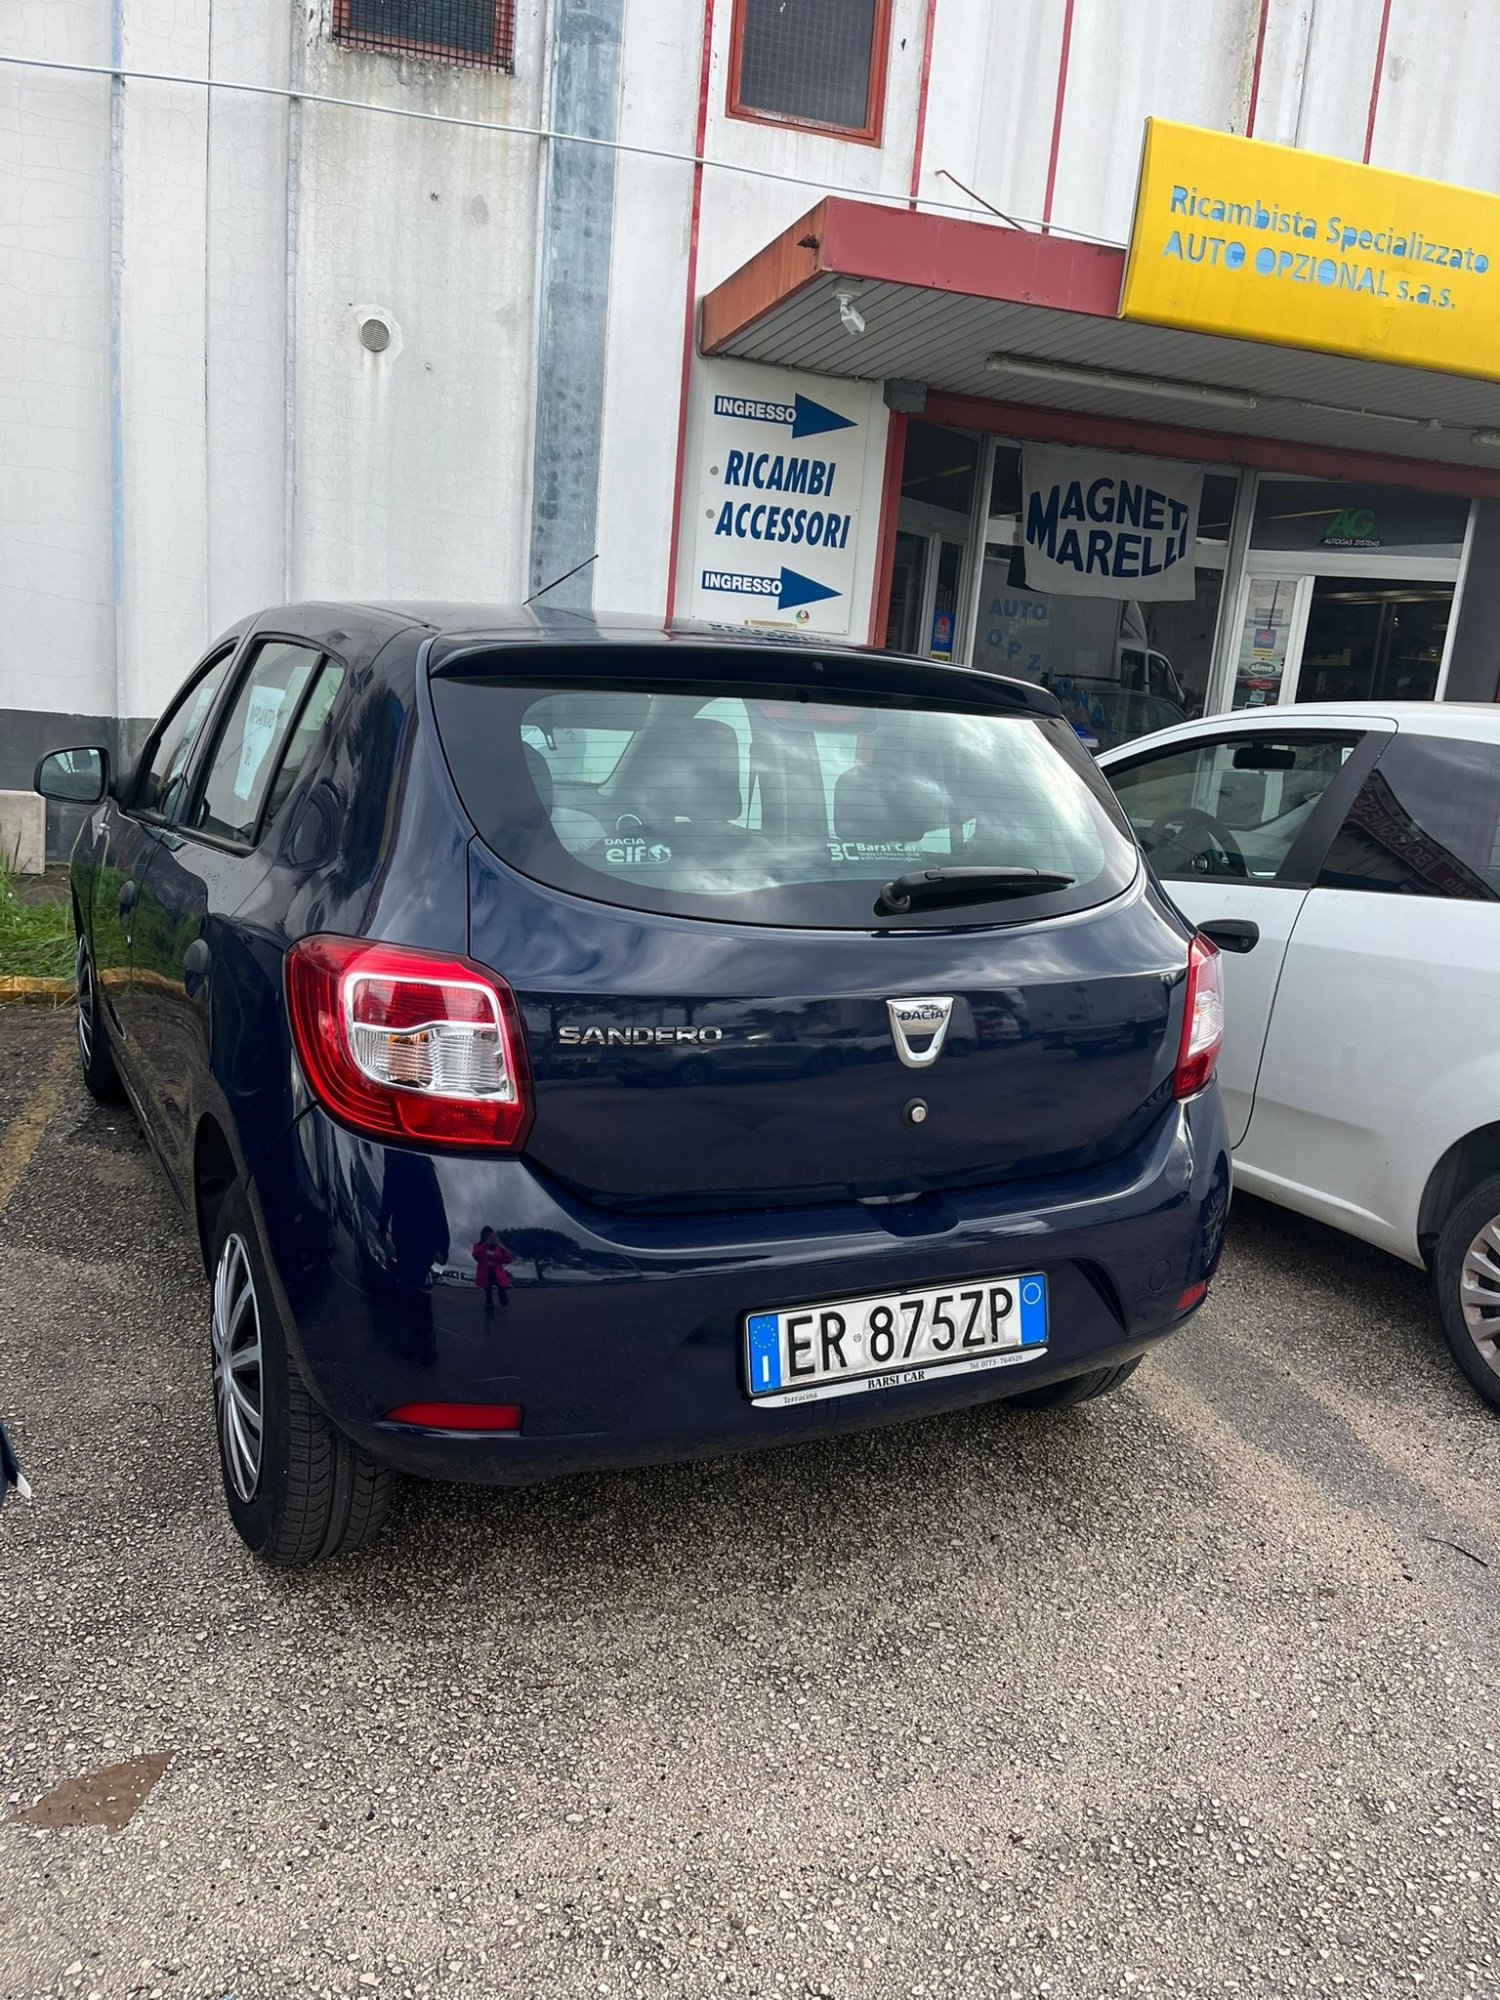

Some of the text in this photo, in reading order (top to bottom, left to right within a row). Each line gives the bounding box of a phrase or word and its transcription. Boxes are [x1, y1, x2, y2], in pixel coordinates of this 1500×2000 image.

[1170, 185, 1489, 274] Ricambista Specializzato
[1162, 231, 1456, 310] AUTO OPZIONAL s.a.s.
[717, 397, 797, 423] INGRESSO
[724, 450, 836, 497] RICAMBI
[714, 501, 851, 549] ACCESSORI
[1026, 477, 1189, 558] MAGNETI
[1326, 508, 1375, 537] AG
[1026, 492, 1189, 578] MARELLI
[1323, 538, 1353, 546] AUTOGAS
[704, 573, 782, 595] INGRESSO
[989, 598, 1048, 621] AUTO
[1250, 663, 1274, 673] slime
[605, 838, 646, 846] DACIA
[857, 842, 918, 852] Barsi Car
[605, 847, 645, 862] elf
[901, 1010, 946, 1022] DACIA
[558, 1025, 723, 1046] SANDERO
[787, 1312, 847, 1377] ER
[870, 1287, 1013, 1362] 875ZP
[868, 1371, 926, 1389] BARSI CAR
[784, 1392, 818, 1404] Terracina
